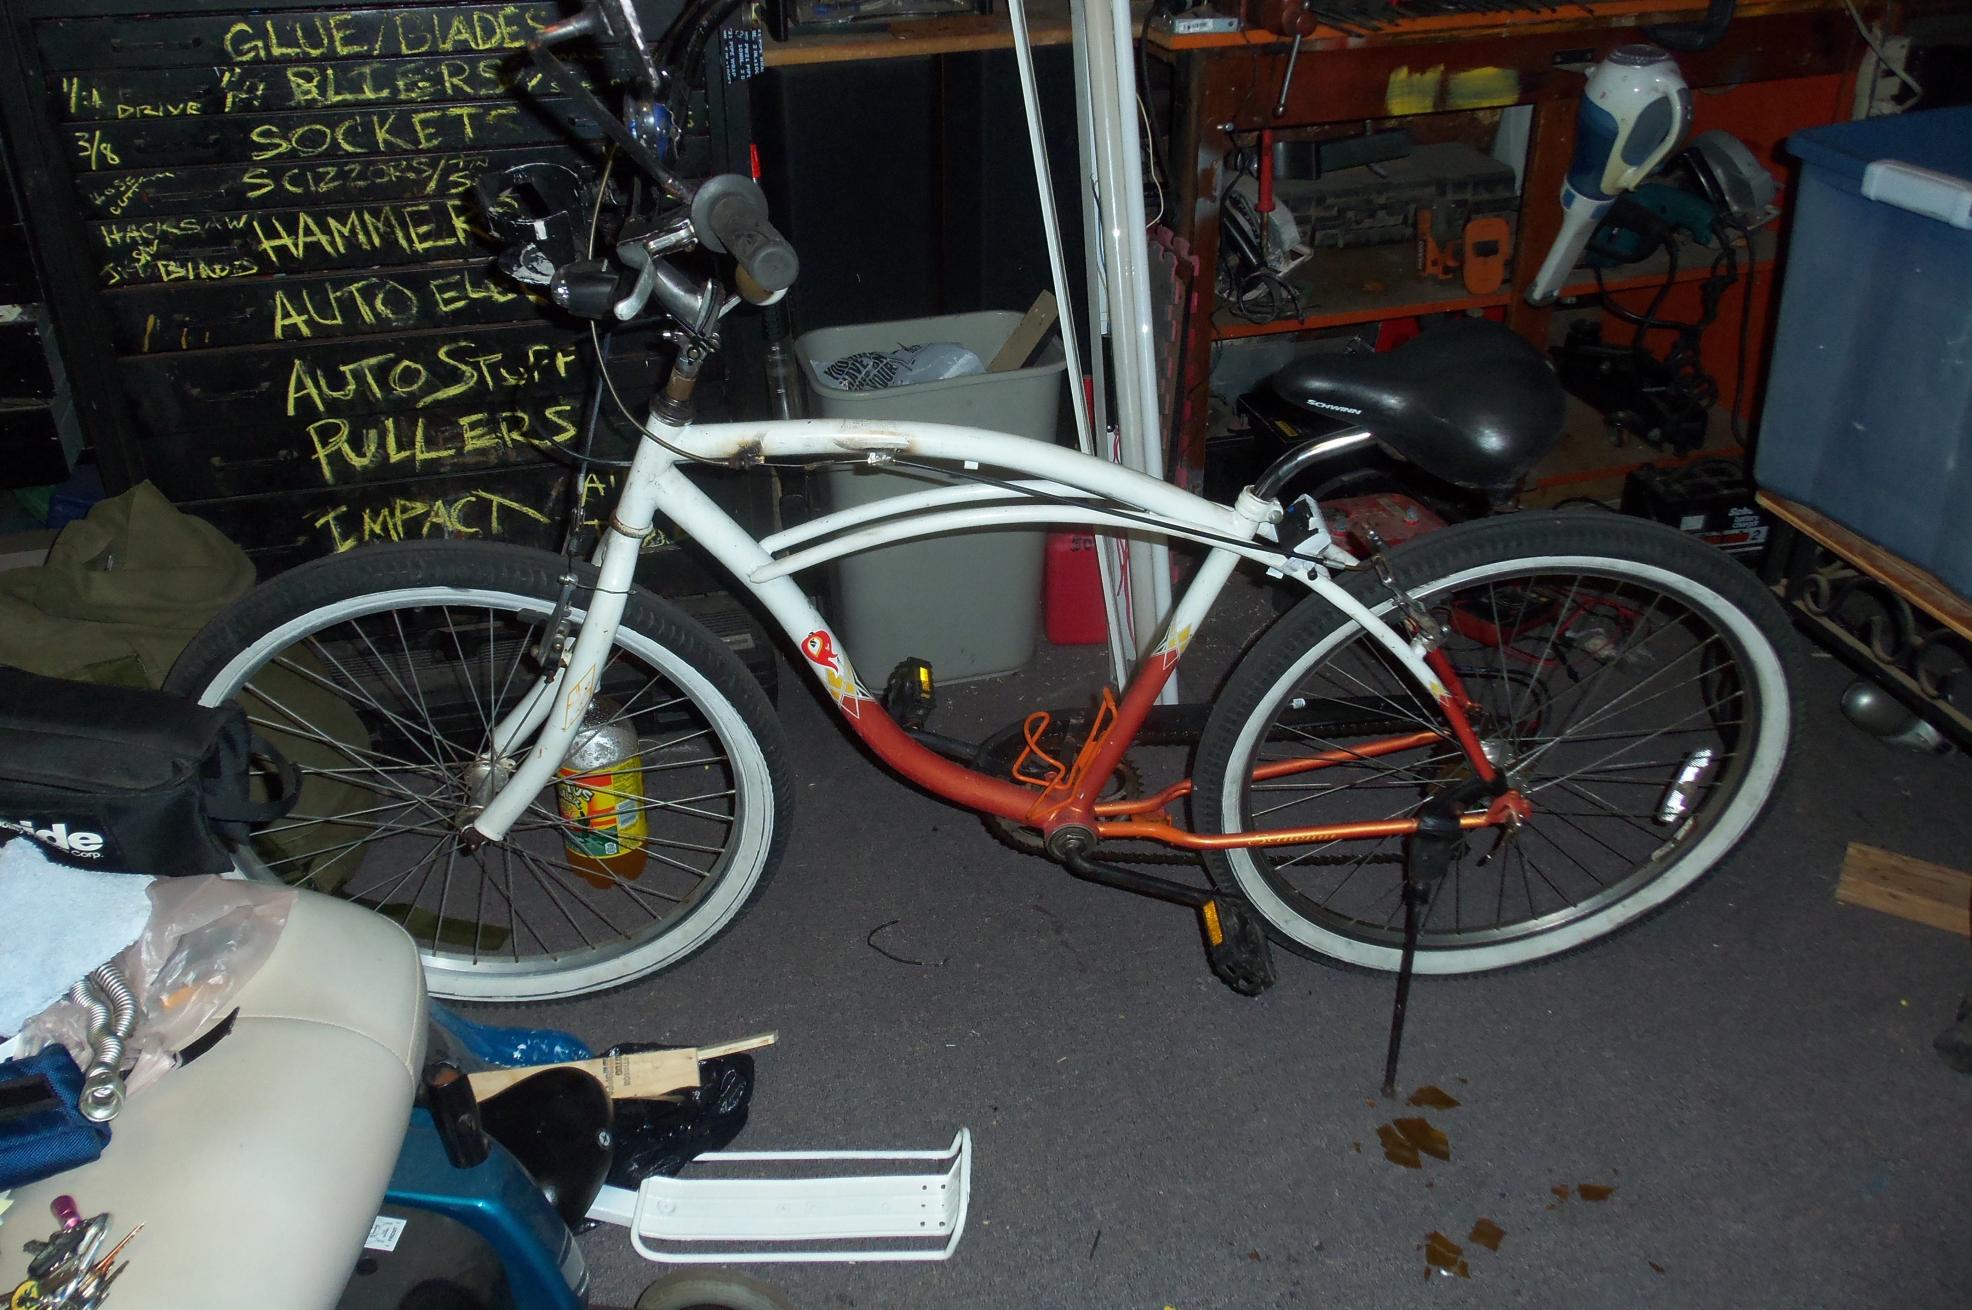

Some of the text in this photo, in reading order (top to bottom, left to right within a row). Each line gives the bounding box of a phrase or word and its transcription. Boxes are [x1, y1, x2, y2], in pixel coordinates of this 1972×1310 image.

[73, 129, 122, 171] 3/8
[272, 277, 420, 341] AUTO
[286, 352, 428, 417] AUTO
[305, 404, 578, 486] PULLERS
[304, 488, 551, 553] IMPACT
